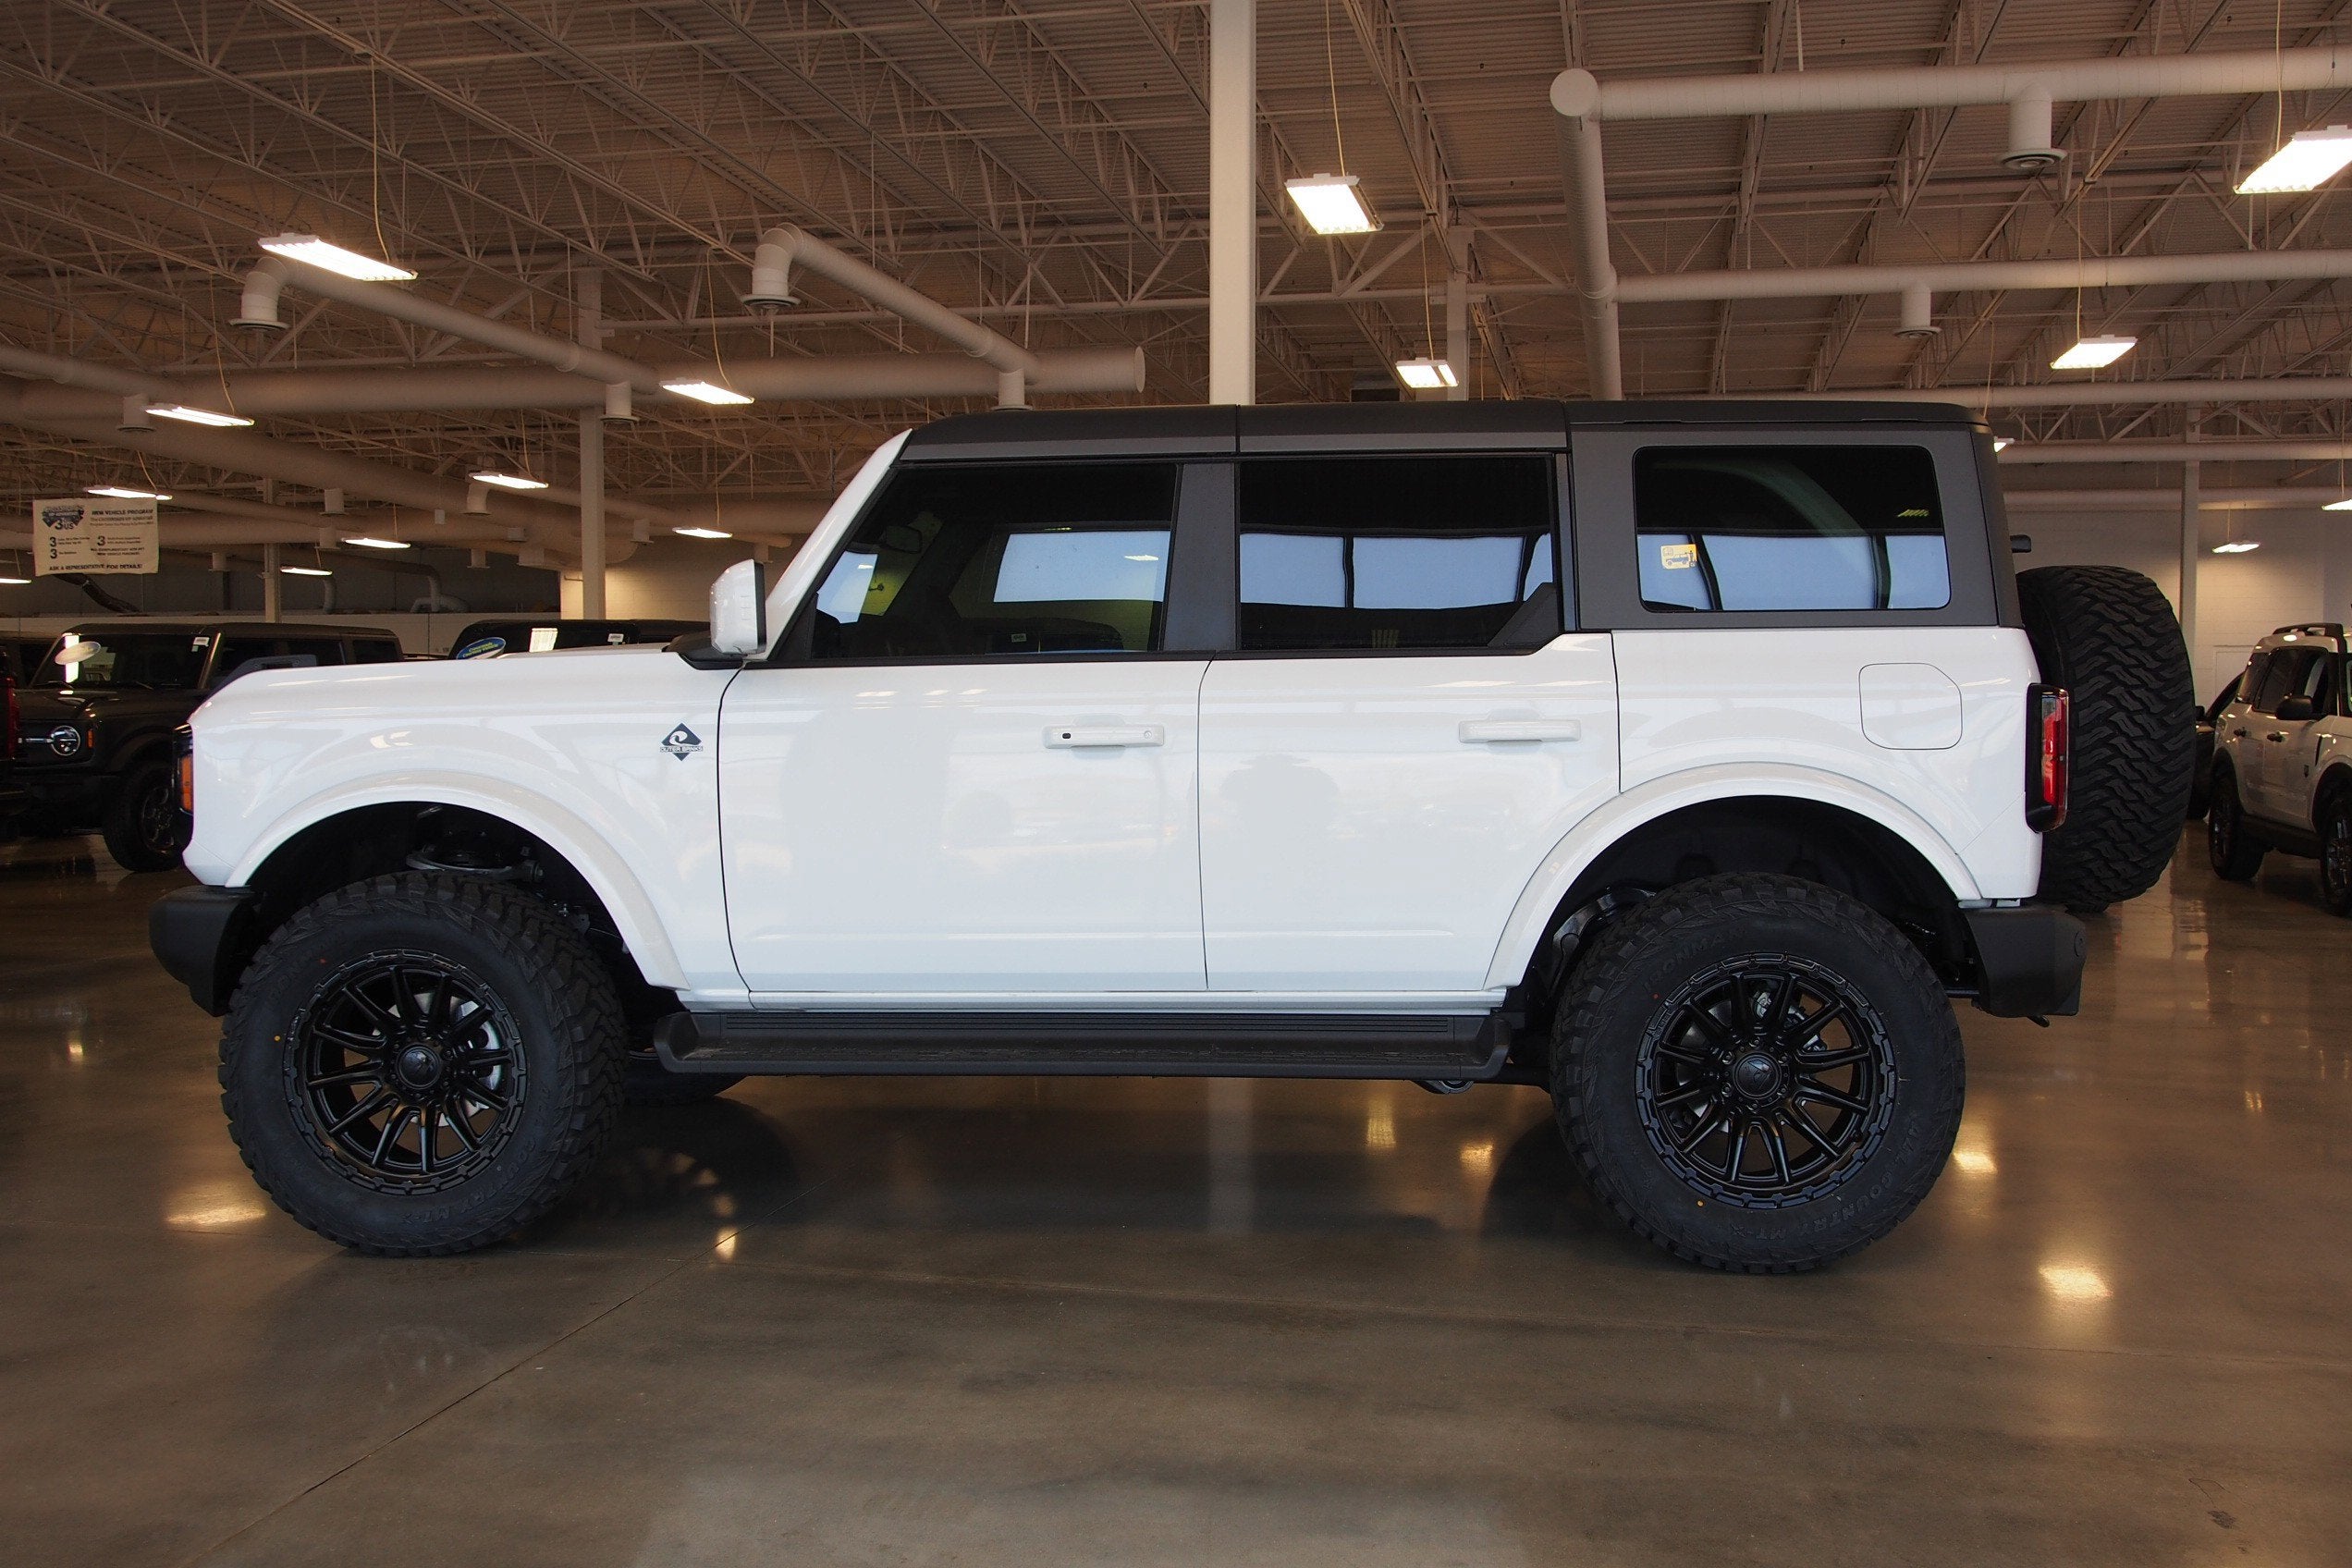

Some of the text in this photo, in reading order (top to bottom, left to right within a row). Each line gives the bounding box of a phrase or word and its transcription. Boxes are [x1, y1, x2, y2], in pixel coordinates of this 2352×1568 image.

[55, 520, 63, 530] 3
[50, 536, 57, 546] 3
[97, 535, 105, 546] 3
[50, 548, 57, 558] 3
